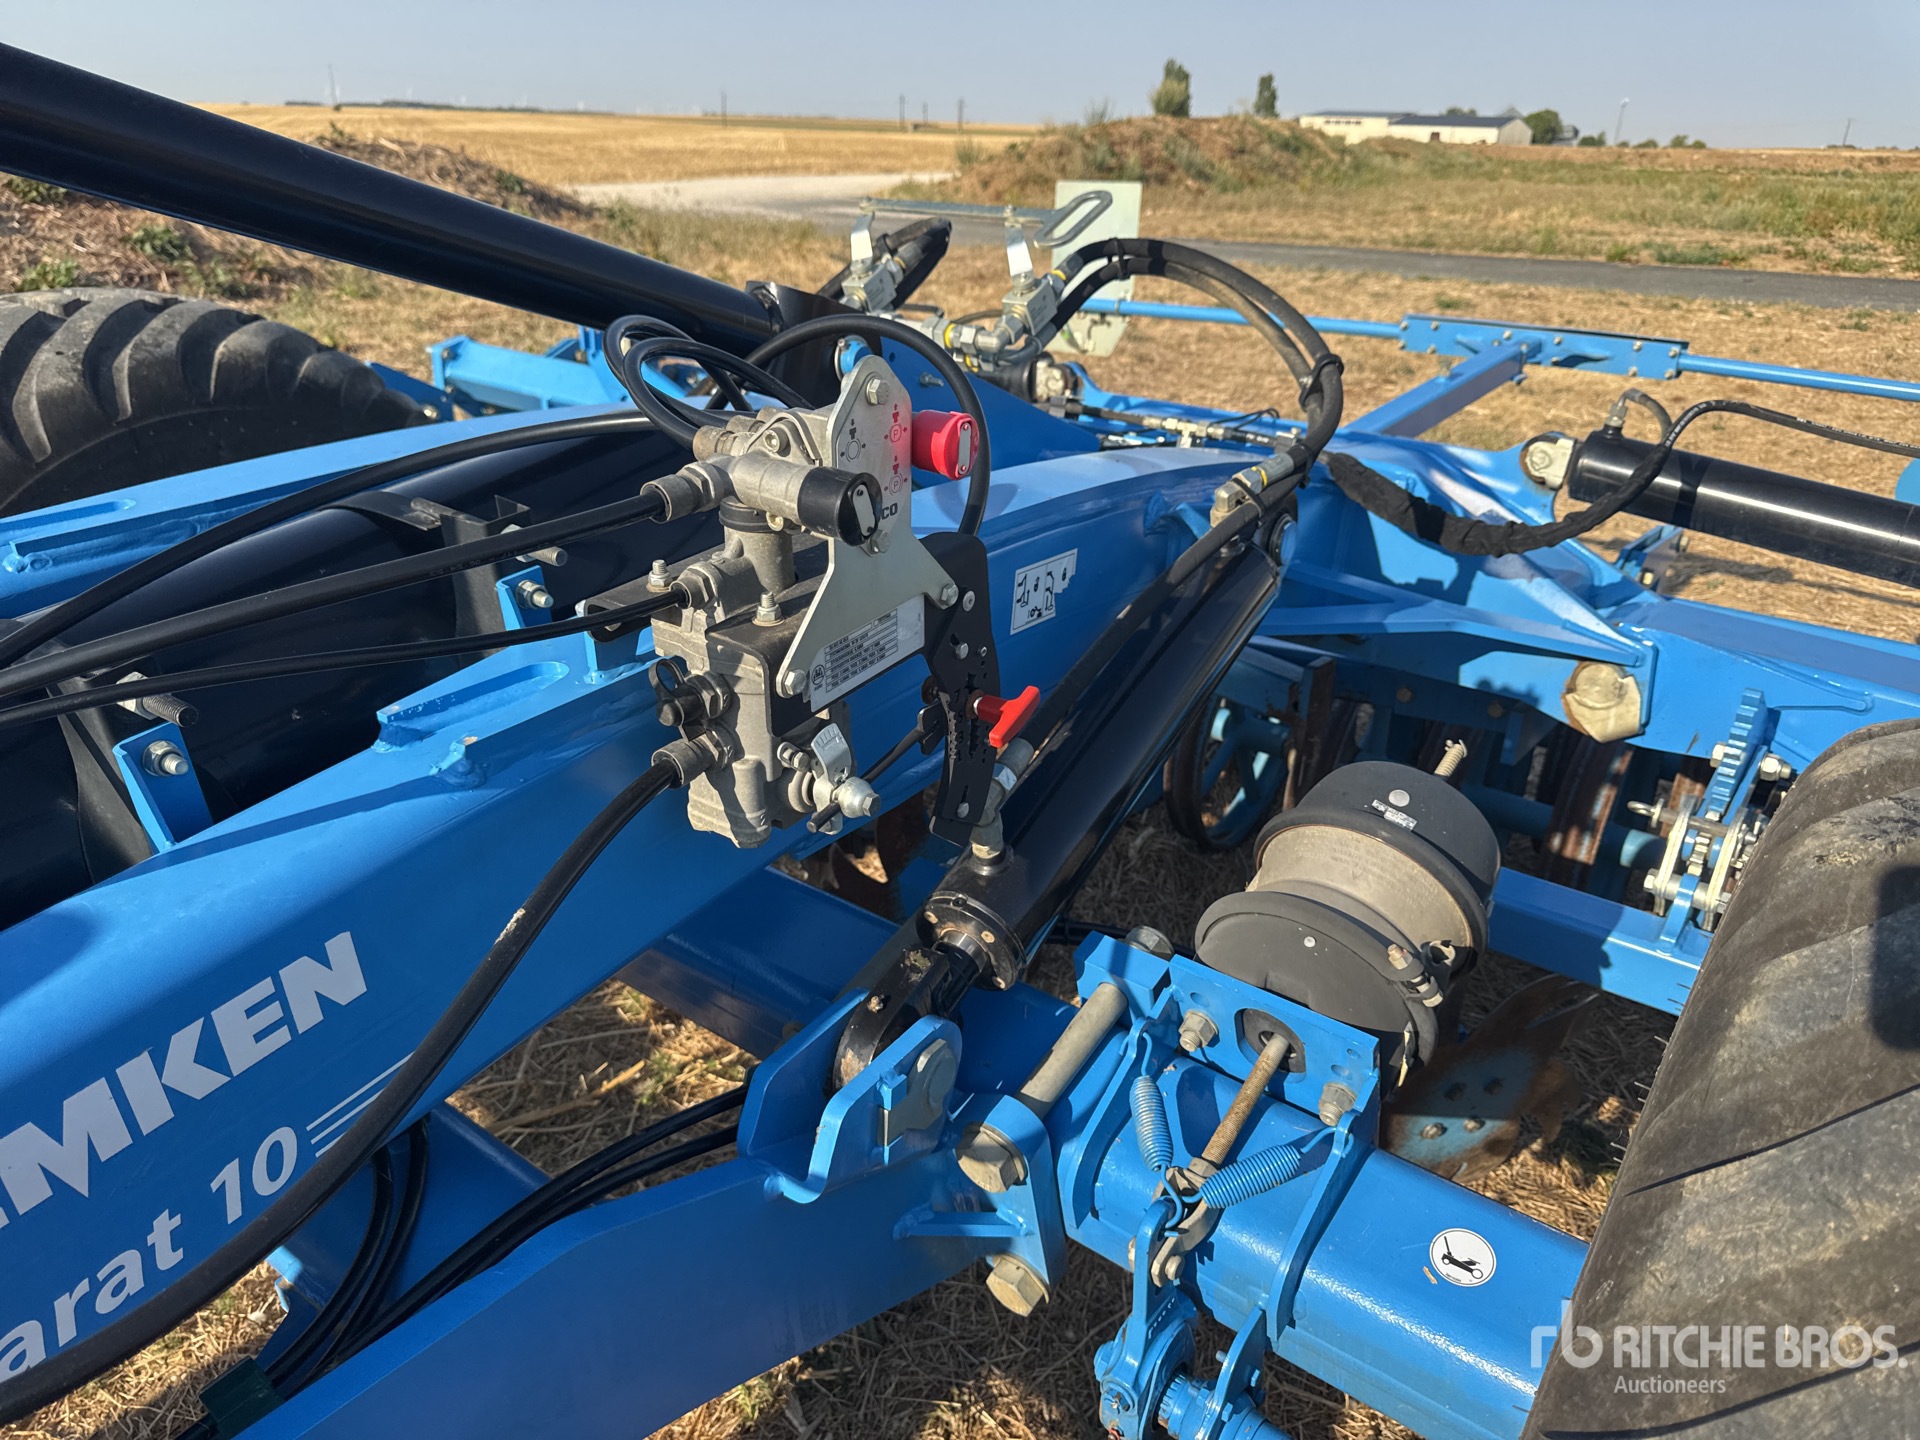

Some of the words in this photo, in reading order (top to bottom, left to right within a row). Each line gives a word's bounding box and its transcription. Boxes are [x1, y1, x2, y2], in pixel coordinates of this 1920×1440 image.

[881, 502, 898, 520] CO
[0, 931, 367, 1229] MKEN
[210, 1126, 298, 1225] 10
